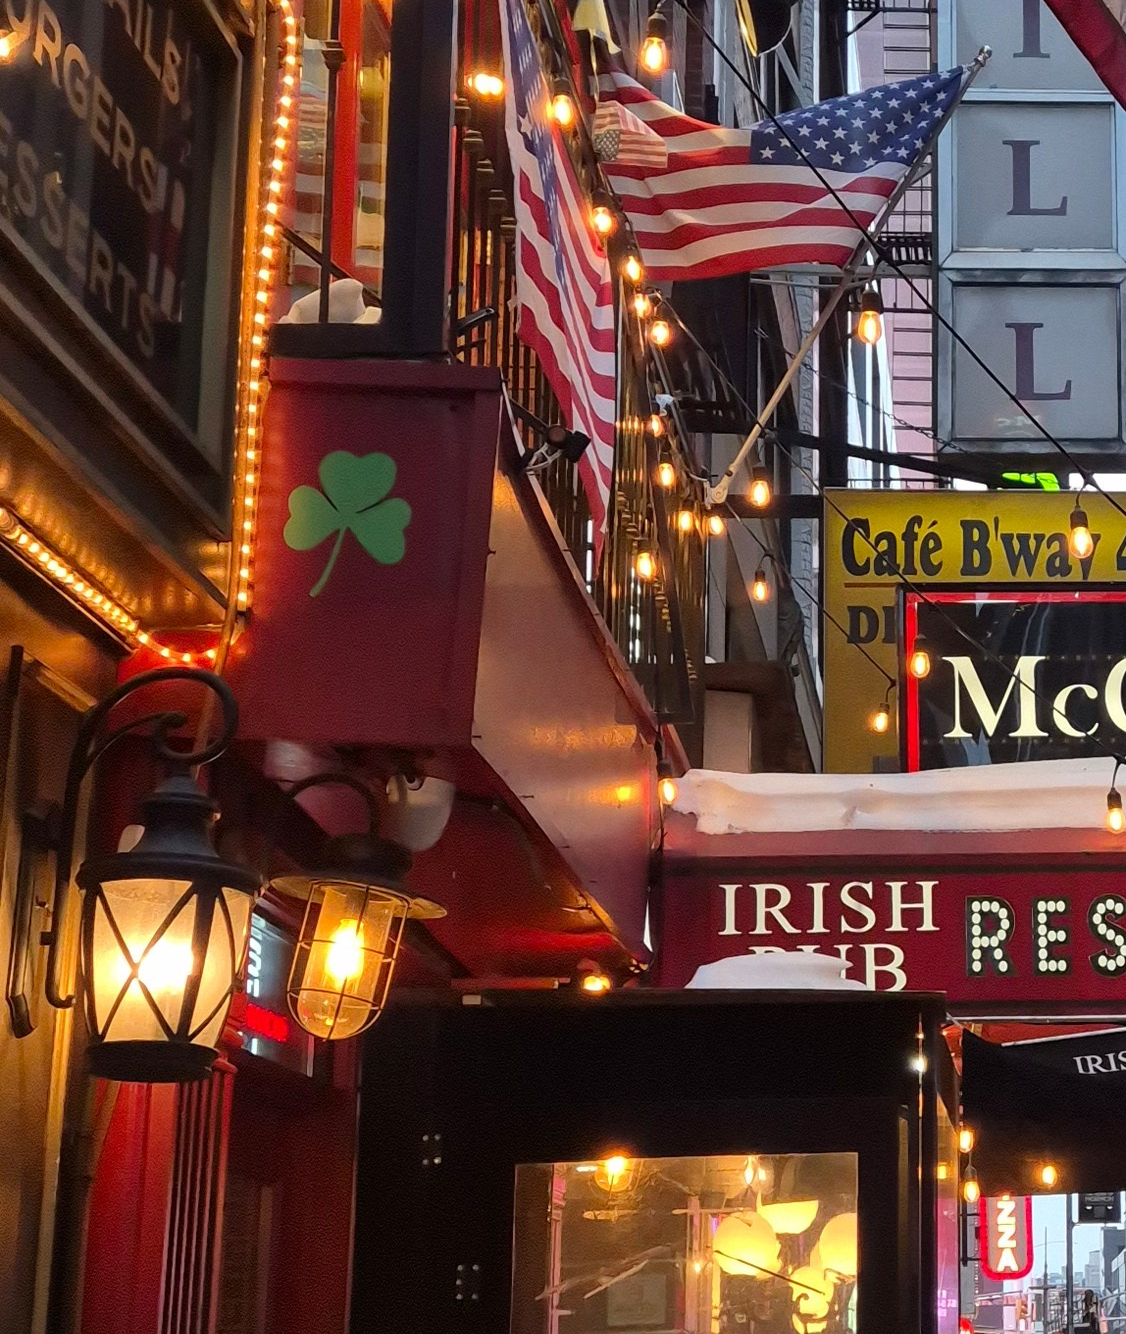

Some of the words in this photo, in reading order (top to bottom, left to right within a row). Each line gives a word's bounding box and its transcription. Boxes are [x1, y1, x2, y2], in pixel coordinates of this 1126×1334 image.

[841, 515, 944, 577] Café
[717, 880, 940, 936] IRISH
[997, 1195, 1018, 1272] ZZA
